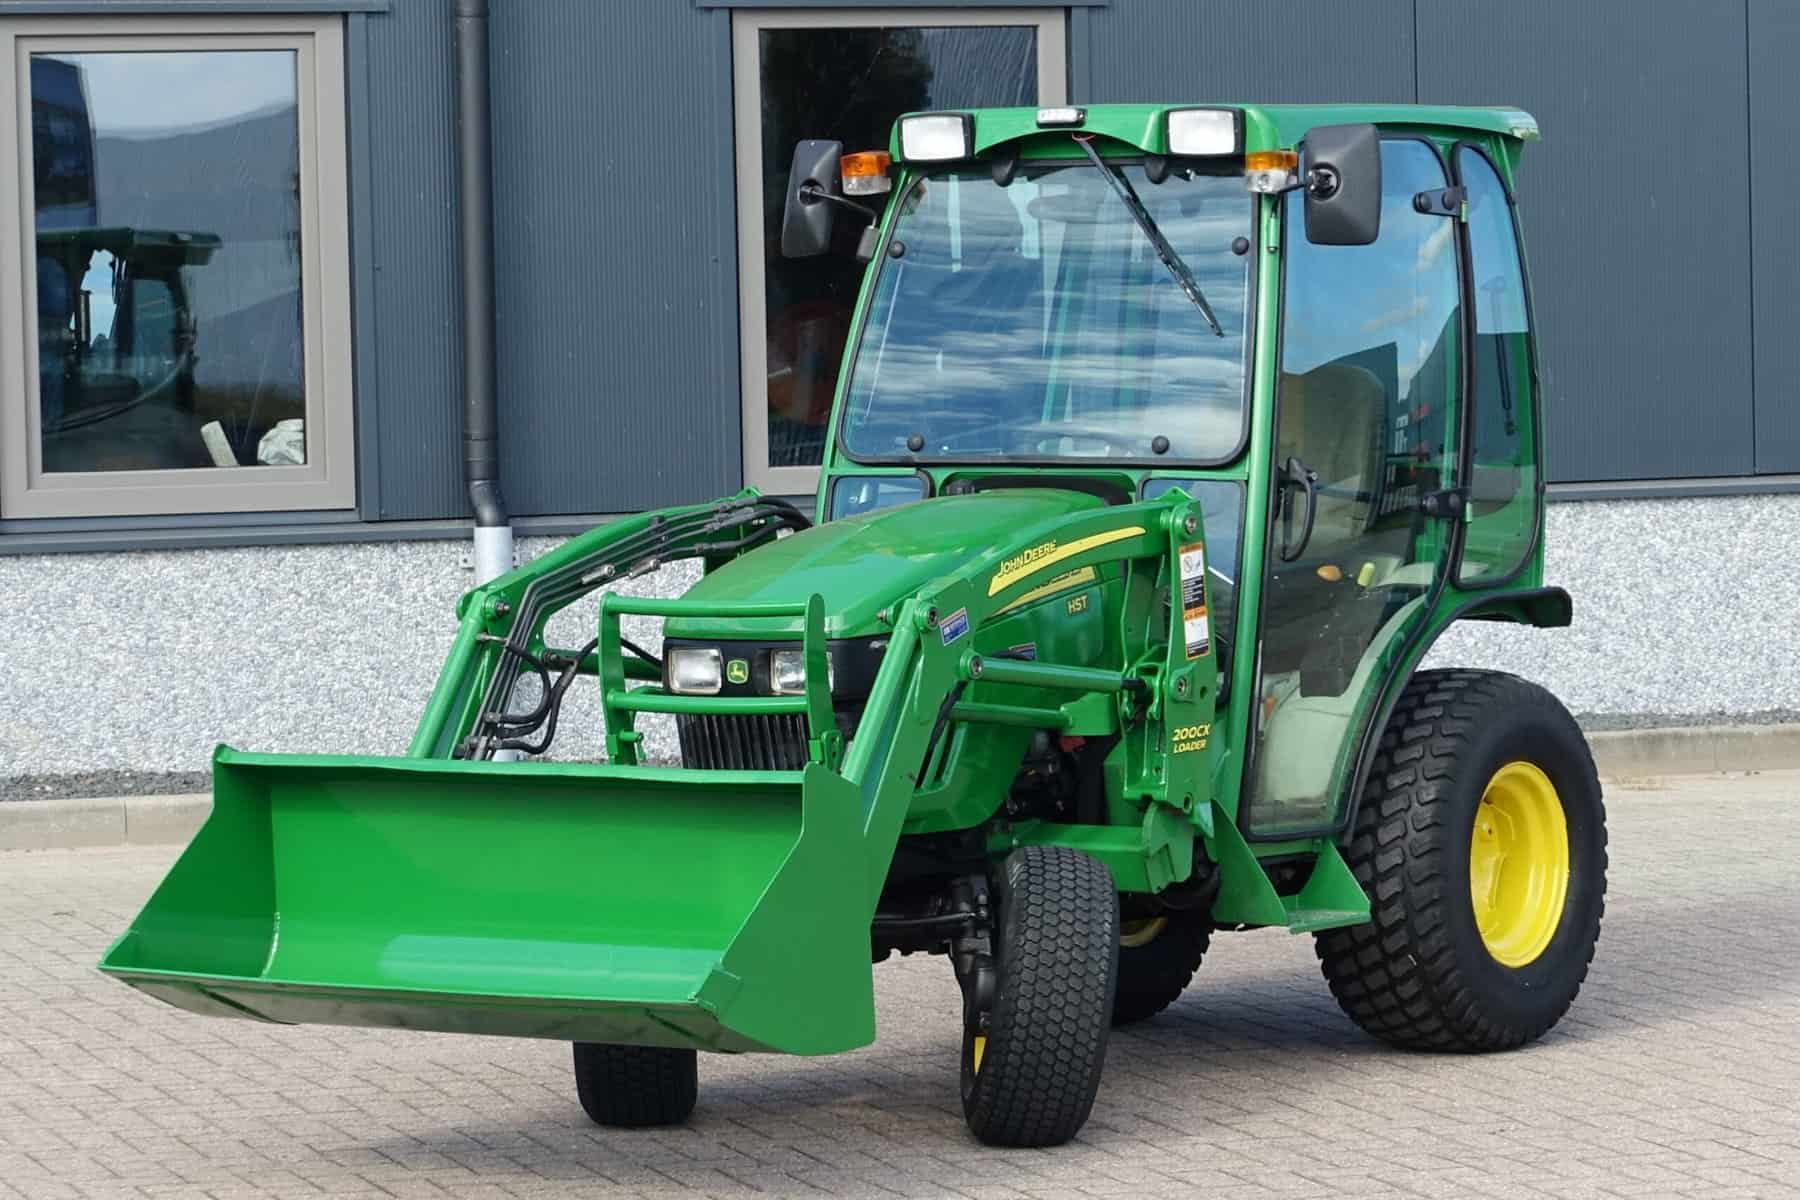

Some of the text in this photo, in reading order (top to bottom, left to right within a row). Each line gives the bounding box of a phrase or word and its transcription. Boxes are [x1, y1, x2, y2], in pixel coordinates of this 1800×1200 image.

[1000, 540, 1057, 577] JOHN DEERE
[1067, 595, 1087, 614] HST
[1172, 723, 1210, 741] 200CX
[1173, 739, 1207, 753] LOADER
